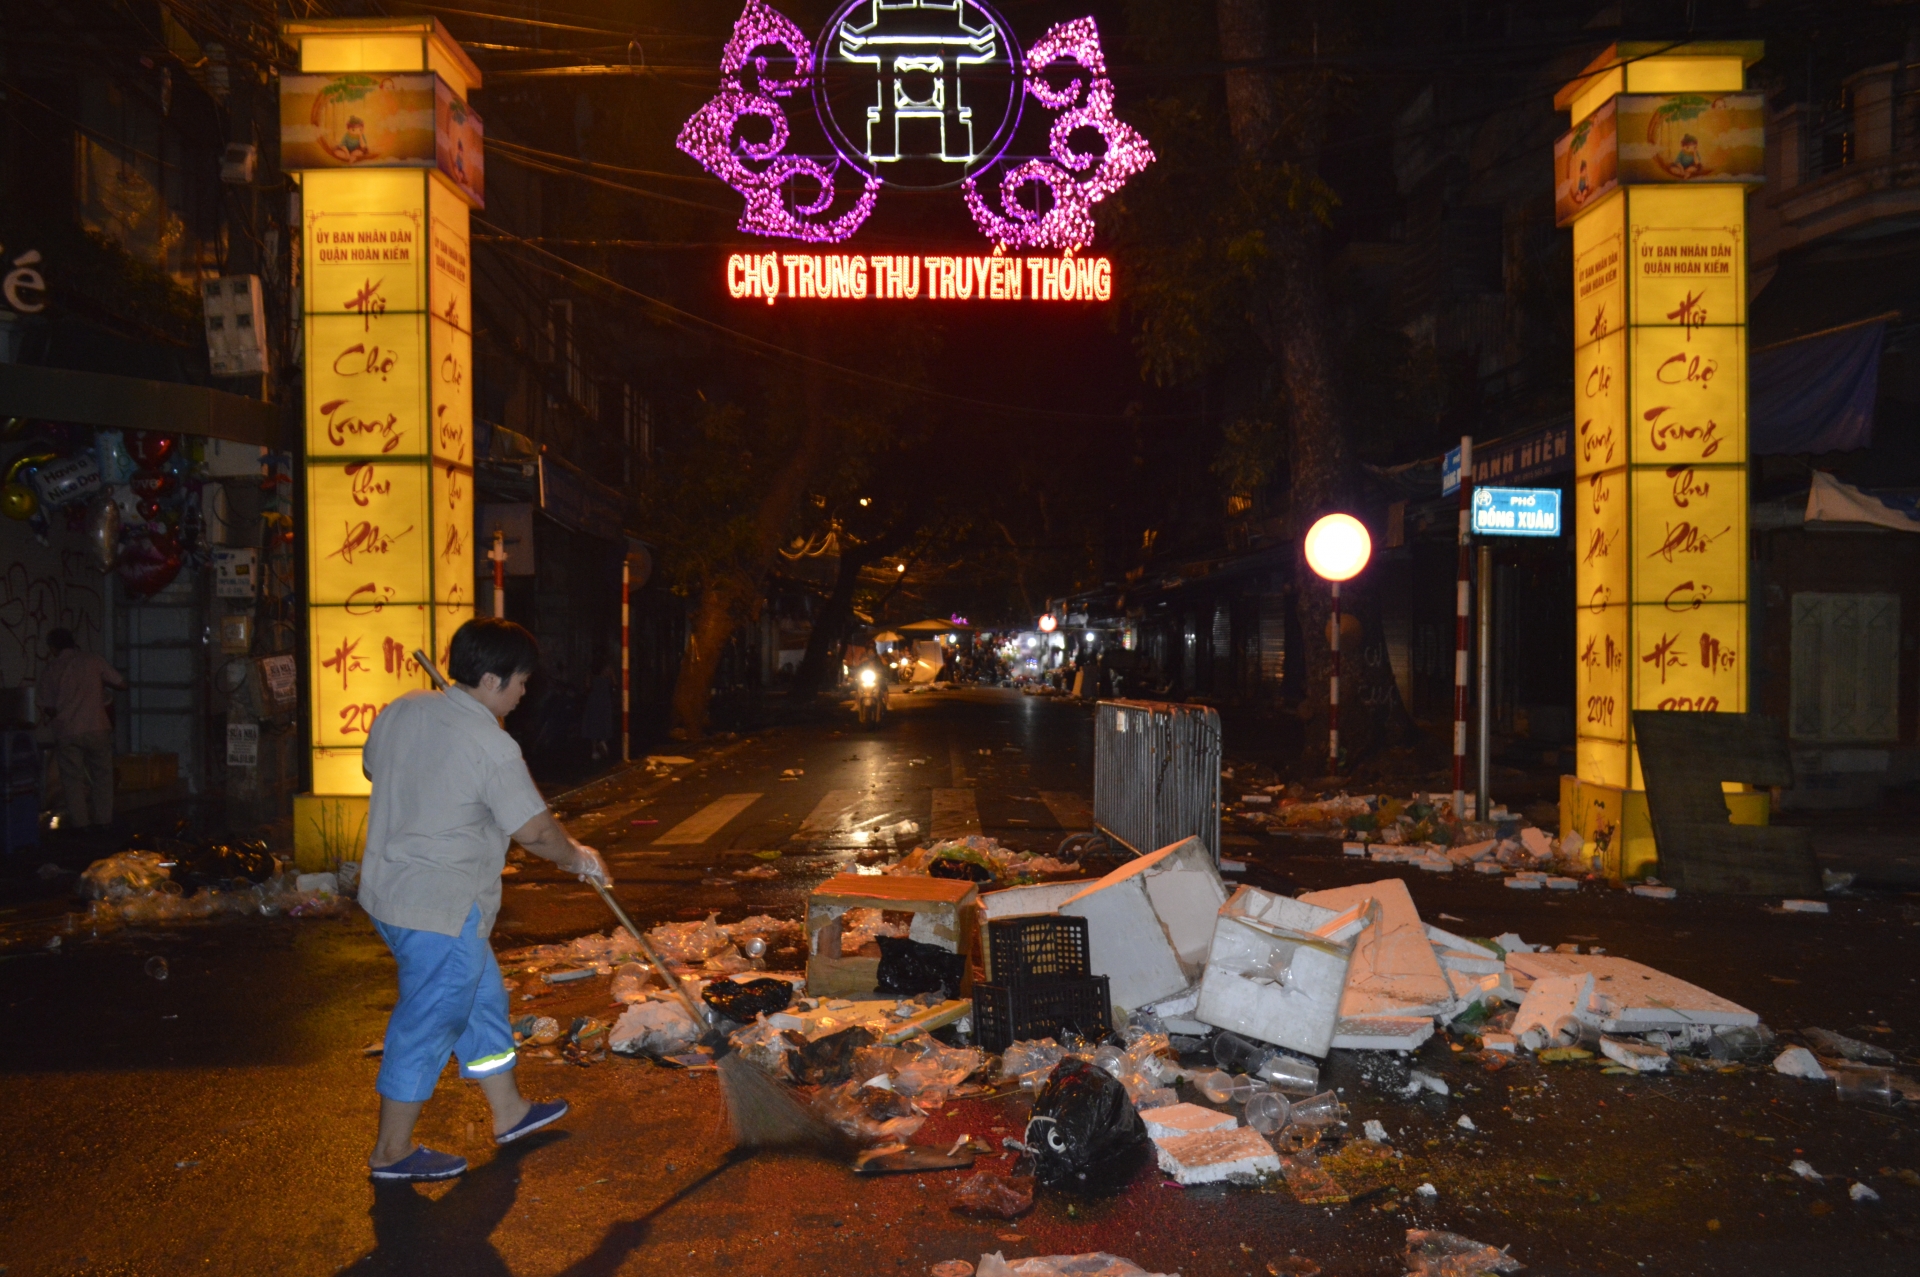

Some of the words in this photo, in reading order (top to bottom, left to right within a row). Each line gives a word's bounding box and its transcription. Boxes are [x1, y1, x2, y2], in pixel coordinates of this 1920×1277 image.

[316, 228, 329, 244] ỦY
[333, 231, 354, 243] BAN
[358, 229, 387, 243] NHÂN
[390, 229, 412, 243] DÂN
[319, 246, 348, 264] QUẬN
[351, 246, 379, 261] HOÀN
[383, 244, 409, 261] KIẾM
[1641, 242, 1654, 257] ỦY
[1657, 246, 1677, 257] BAN
[1680, 244, 1708, 257] NHÂN
[1711, 244, 1731, 257] DÂN
[0, 243, 46, 312] é
[728, 251, 779, 305] CHỢ
[783, 255, 867, 298] TRUNG
[871, 255, 920, 299] THU
[925, 242, 1021, 299] TRUYỀN
[1027, 242, 1111, 301] THỐNG
[1644, 260, 1671, 277] QUẬN
[1674, 260, 1701, 274] HOÀN
[1704, 258, 1729, 274] KIẾM
[1666, 288, 1707, 341] Hội
[333, 343, 398, 382] Chợ
[1656, 352, 1718, 389] Chợ
[320, 399, 409, 453] Trung
[1581, 418, 1616, 463] Trung
[1643, 406, 1728, 458] Trung
[43, 463, 78, 484] Have
[78, 460, 87, 468] a
[47, 482, 78, 501] Nice
[76, 472, 101, 486] Day
[344, 461, 391, 506] Thu
[1666, 465, 1710, 508] Thu
[1510, 494, 1536, 506] PHỐ
[1518, 509, 1554, 529] XUÂN
[326, 521, 414, 564] Phố
[1646, 521, 1731, 563] Phố
[322, 635, 370, 691] Hà
[1642, 631, 1688, 685] Hà
[339, 703, 389, 734] 20
[1588, 696, 1614, 727] 2019
